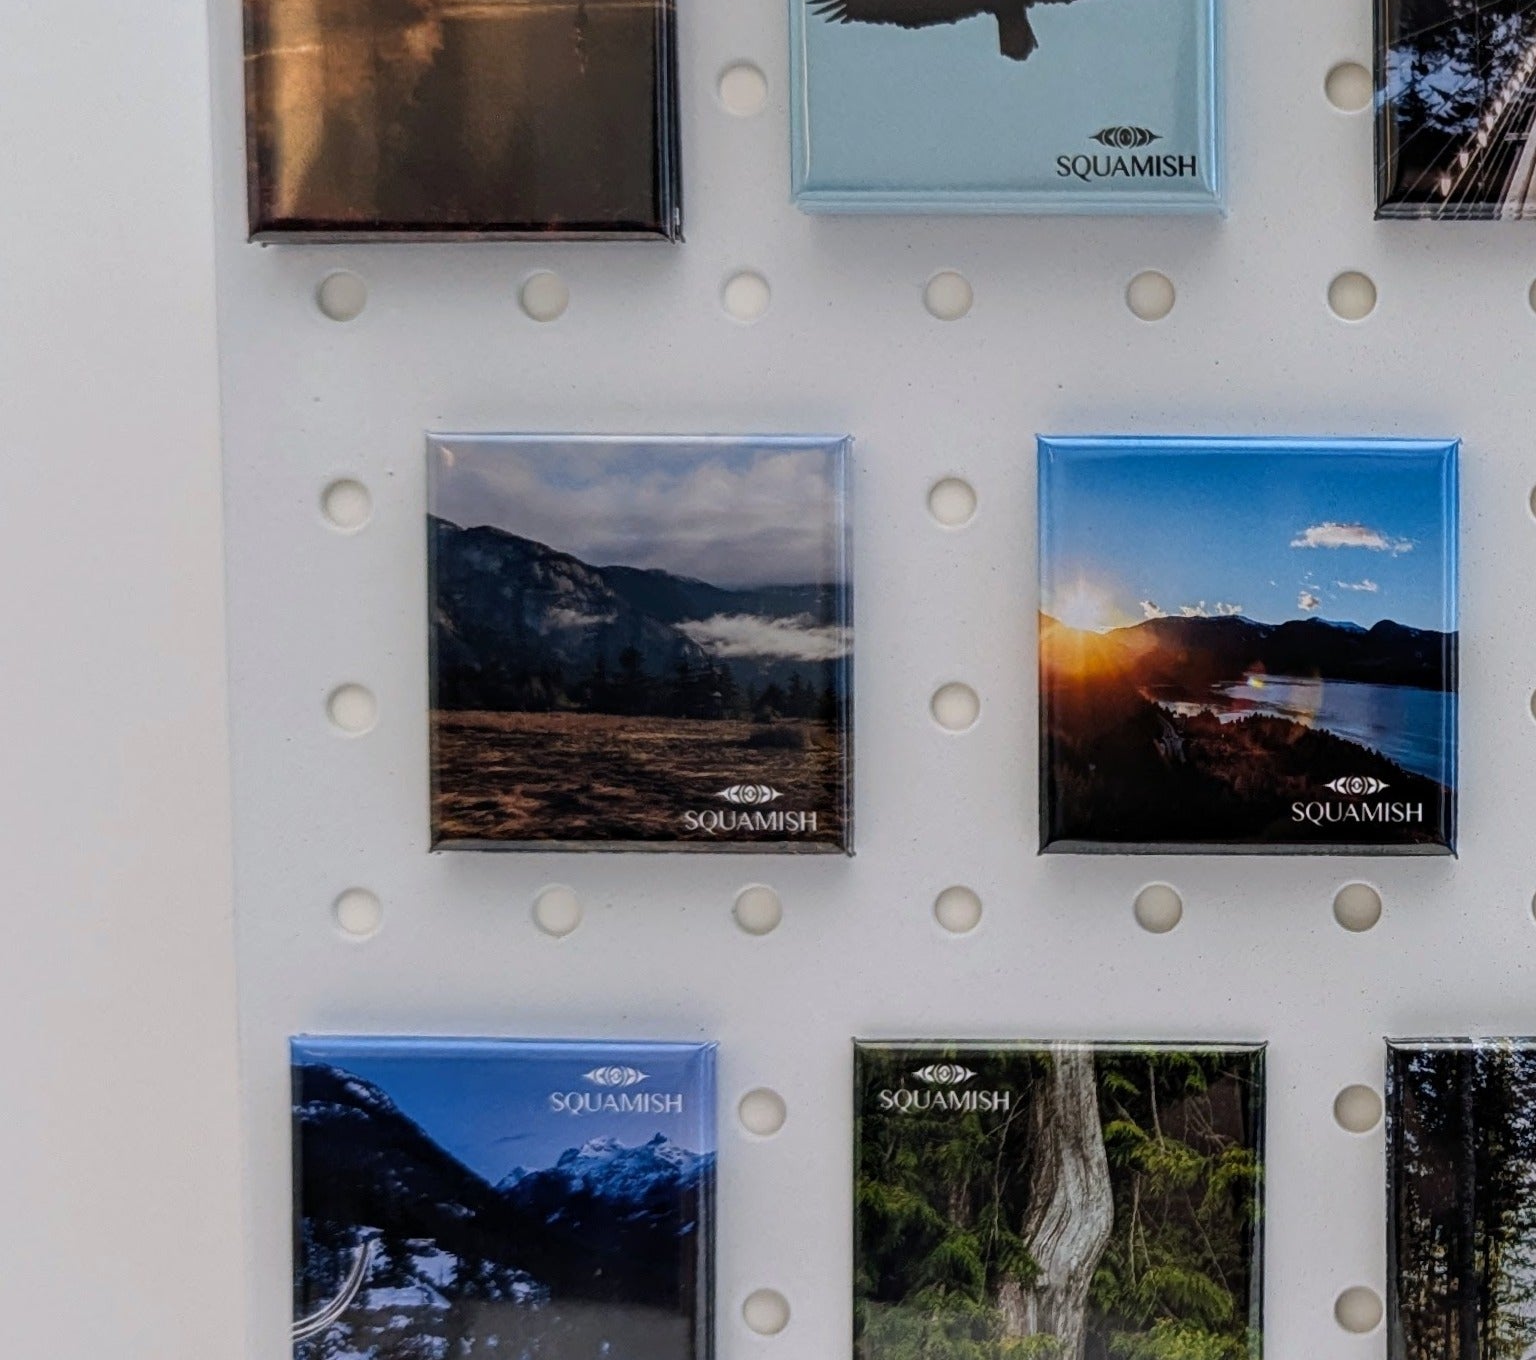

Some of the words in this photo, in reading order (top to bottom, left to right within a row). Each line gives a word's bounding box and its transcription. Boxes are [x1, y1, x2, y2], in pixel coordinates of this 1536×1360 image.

[1056, 154, 1197, 182] SQUAMISH
[684, 809, 818, 835] SQUAMISH
[1291, 801, 1423, 826] SQUAMISH
[549, 1091, 683, 1117] SQUAMISH
[879, 1088, 1011, 1114] SQUAMISH
